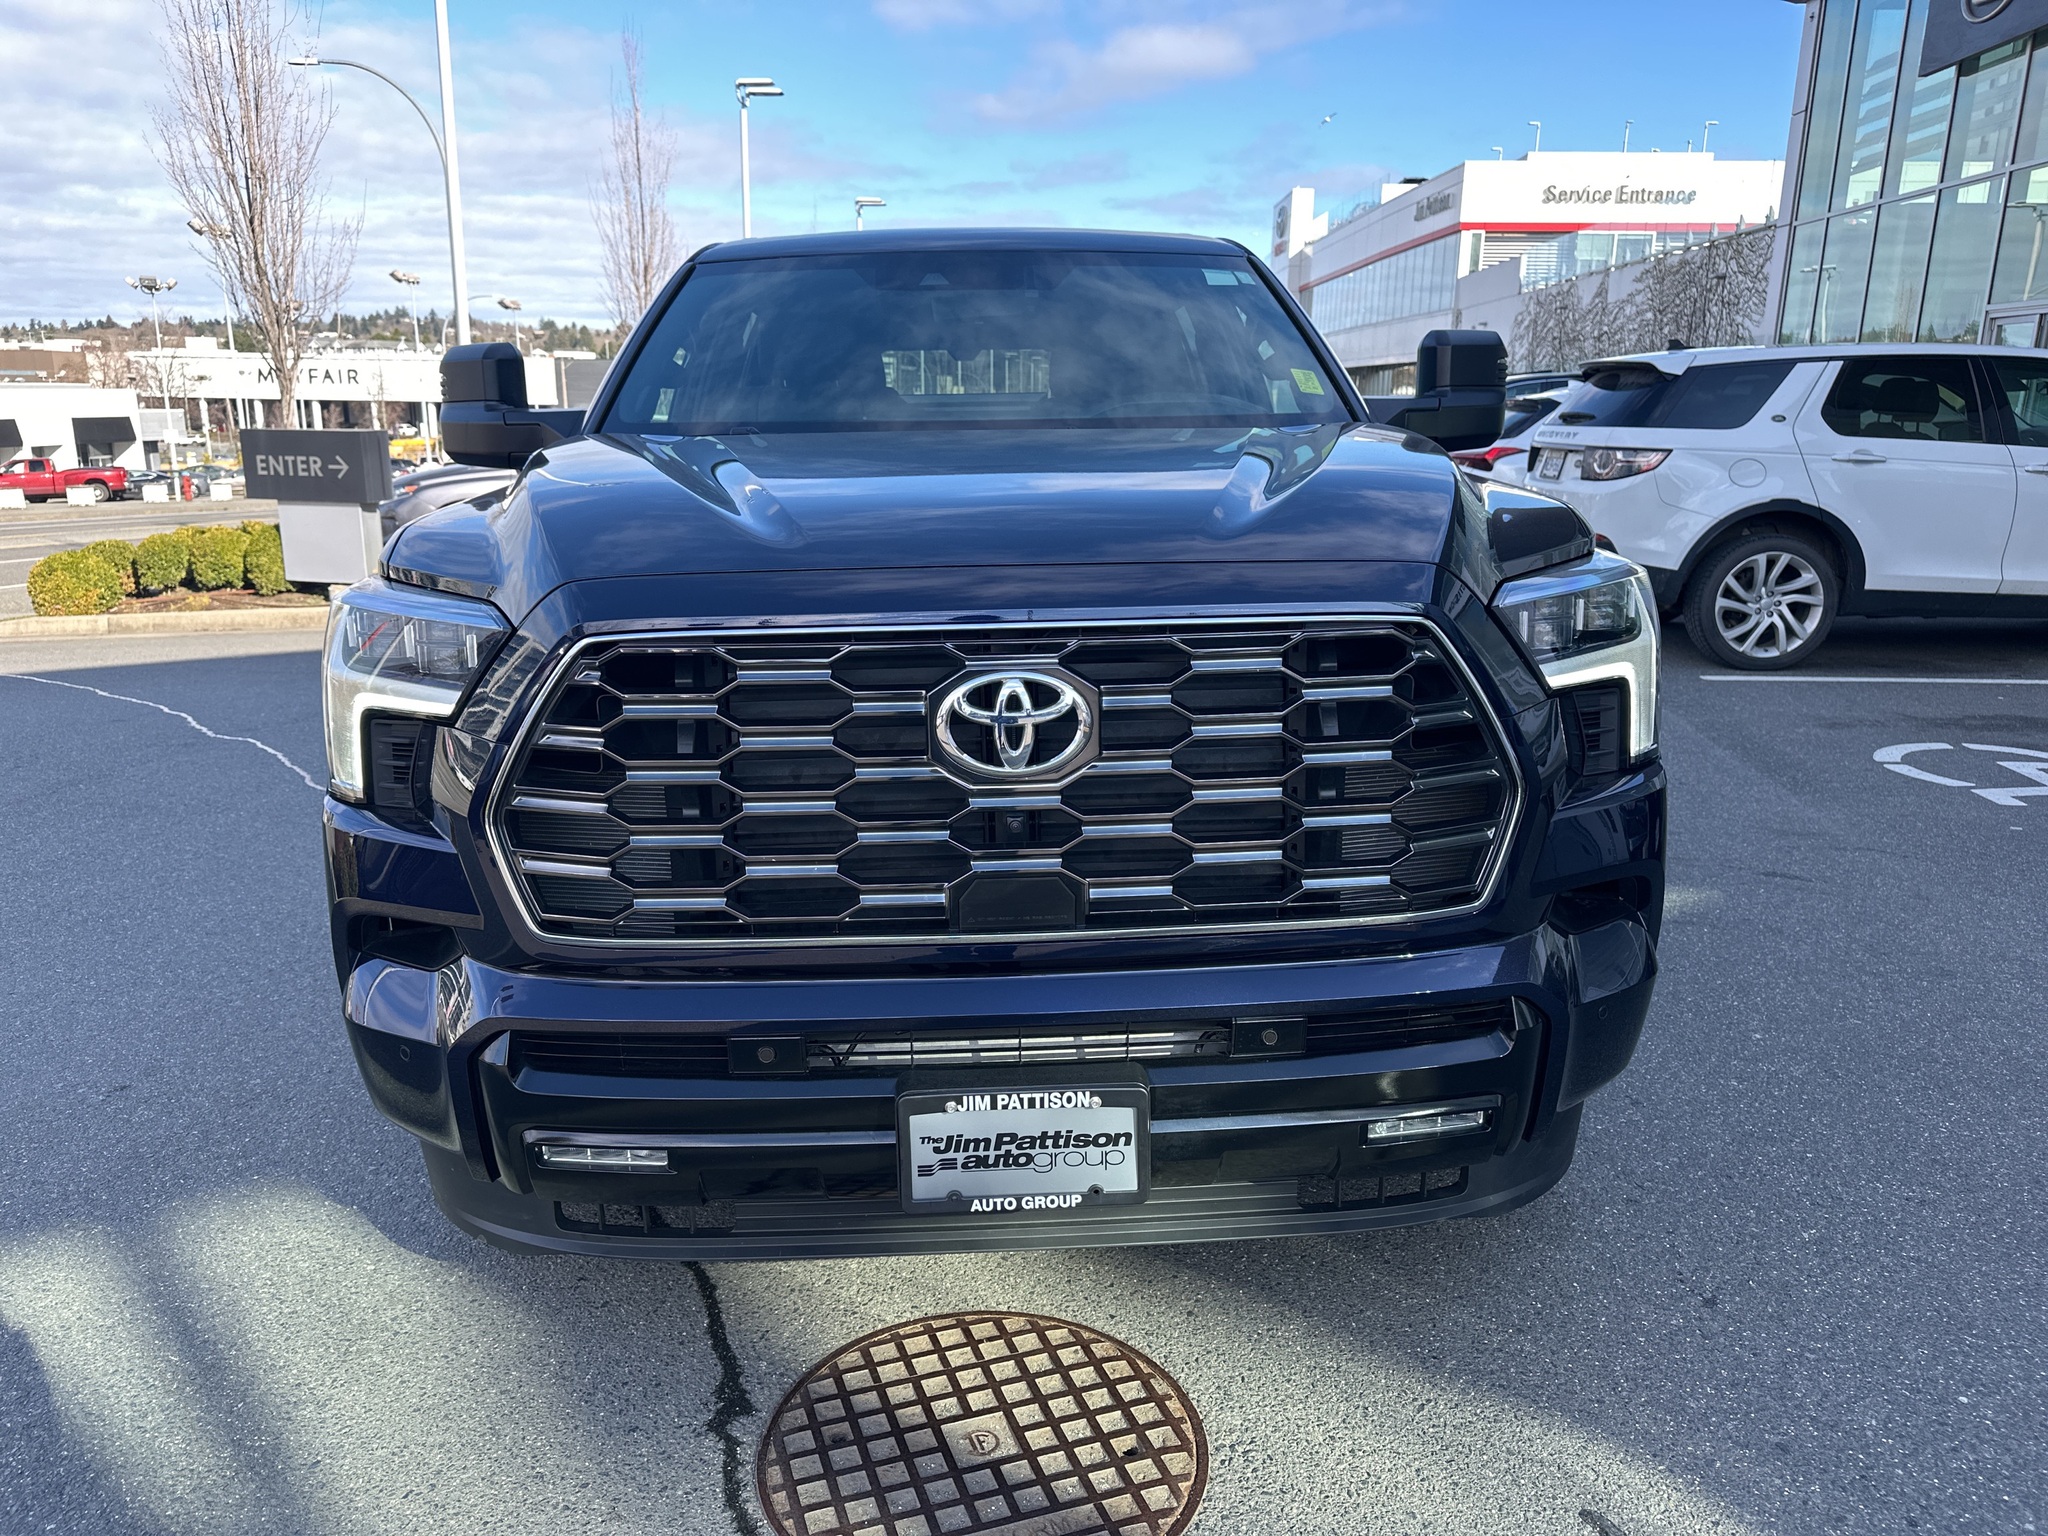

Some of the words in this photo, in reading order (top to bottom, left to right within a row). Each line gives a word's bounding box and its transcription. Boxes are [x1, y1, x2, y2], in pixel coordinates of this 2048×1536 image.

[1542, 184, 1612, 205] Service
[1614, 184, 1697, 205] Entrance
[256, 454, 324, 477] ENTER
[957, 1094, 991, 1112] JIM
[996, 1091, 1090, 1110] PATTISON
[919, 1135, 944, 1145] The
[933, 1134, 992, 1154] Jim
[993, 1129, 1133, 1151] Pattison
[970, 1197, 1017, 1213] AUTO
[1021, 1194, 1082, 1210] GROUP
